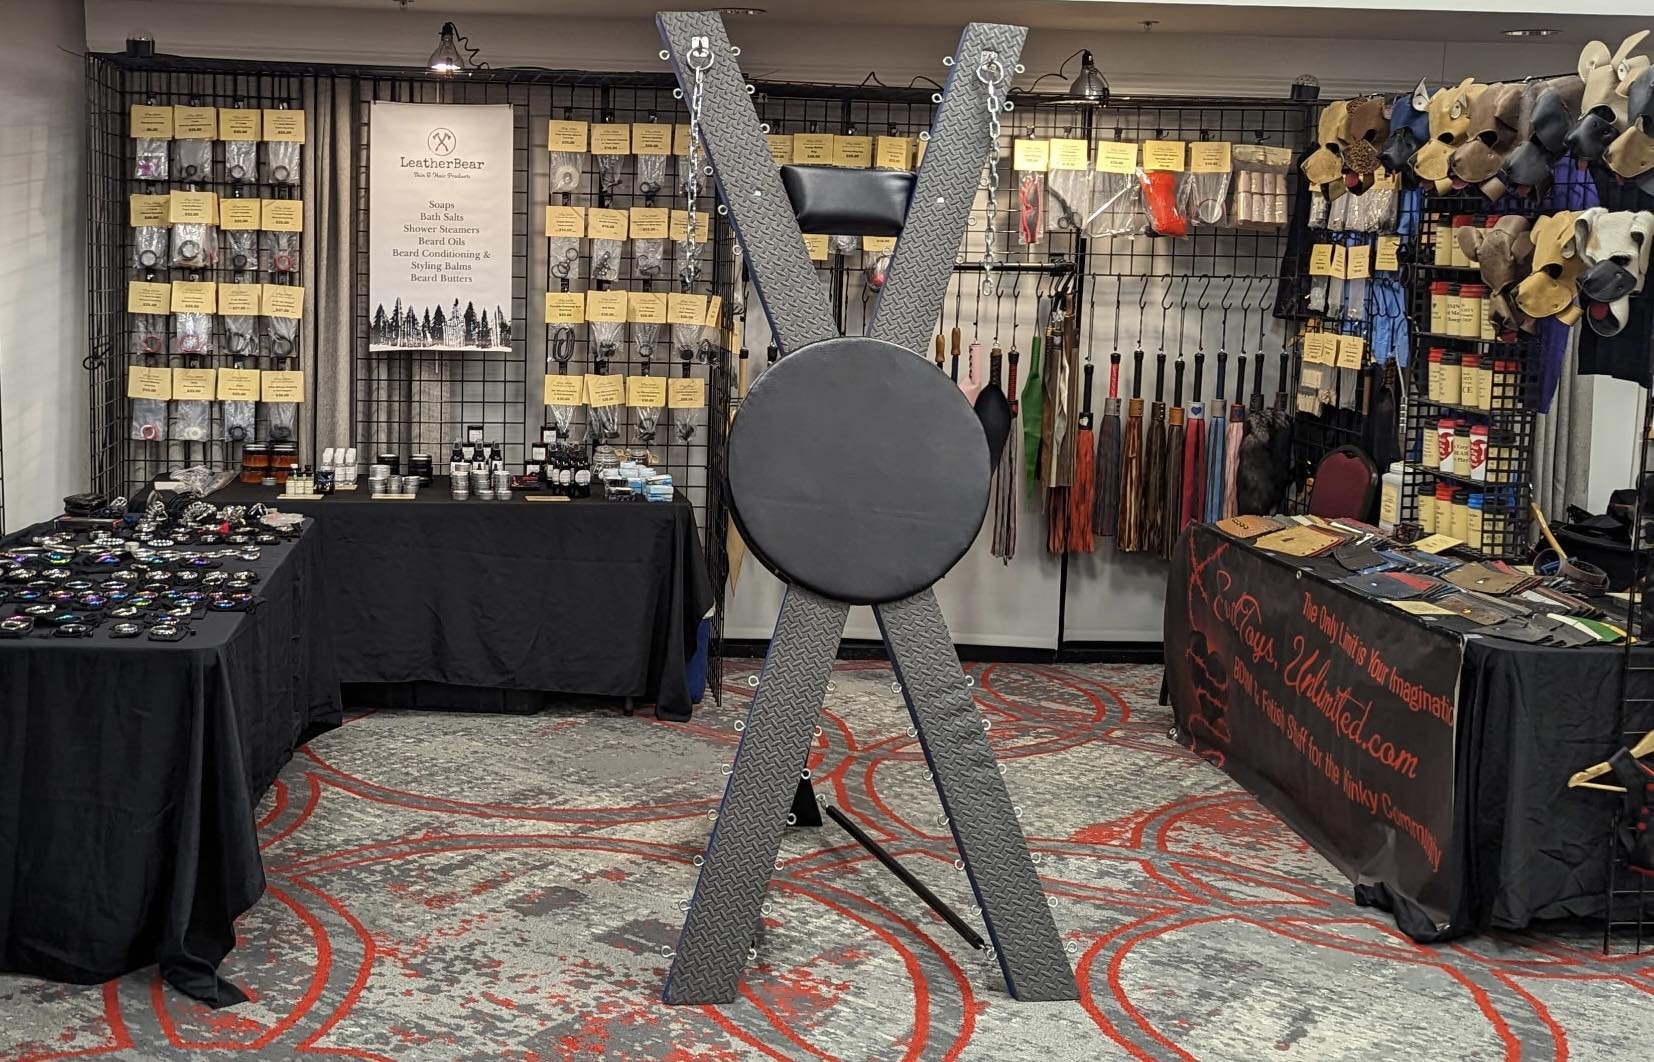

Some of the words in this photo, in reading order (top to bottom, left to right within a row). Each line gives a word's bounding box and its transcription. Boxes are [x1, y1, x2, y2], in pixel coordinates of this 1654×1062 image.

[400, 156, 485, 170] LeatherBear
[428, 200, 455, 211] Soaps
[420, 212, 441, 221] Bath
[443, 212, 464, 222] Salts
[403, 224, 437, 233] Shower
[439, 225, 480, 234] Steamers
[418, 237, 445, 246] Beard
[447, 237, 466, 246] Oils
[392, 248, 419, 257] Beard
[421, 249, 481, 261] Conditioning
[483, 250, 492, 259] &
[411, 261, 442, 272] Styling
[444, 262, 472, 271] Balms
[410, 273, 437, 282] Beard
[440, 274, 473, 283] Butters
[1303, 592, 1318, 623] The
[1319, 606, 1337, 645] Only
[1338, 622, 1358, 661] Limit
[1357, 642, 1367, 666] is
[1367, 648, 1390, 685] Your
[1284, 635, 1419, 779] Unlimited.com
[1286, 714, 1307, 756] Stuff
[1307, 735, 1323, 769] for
[1324, 753, 1340, 785] the
[1342, 767, 1379, 815] Kinky
